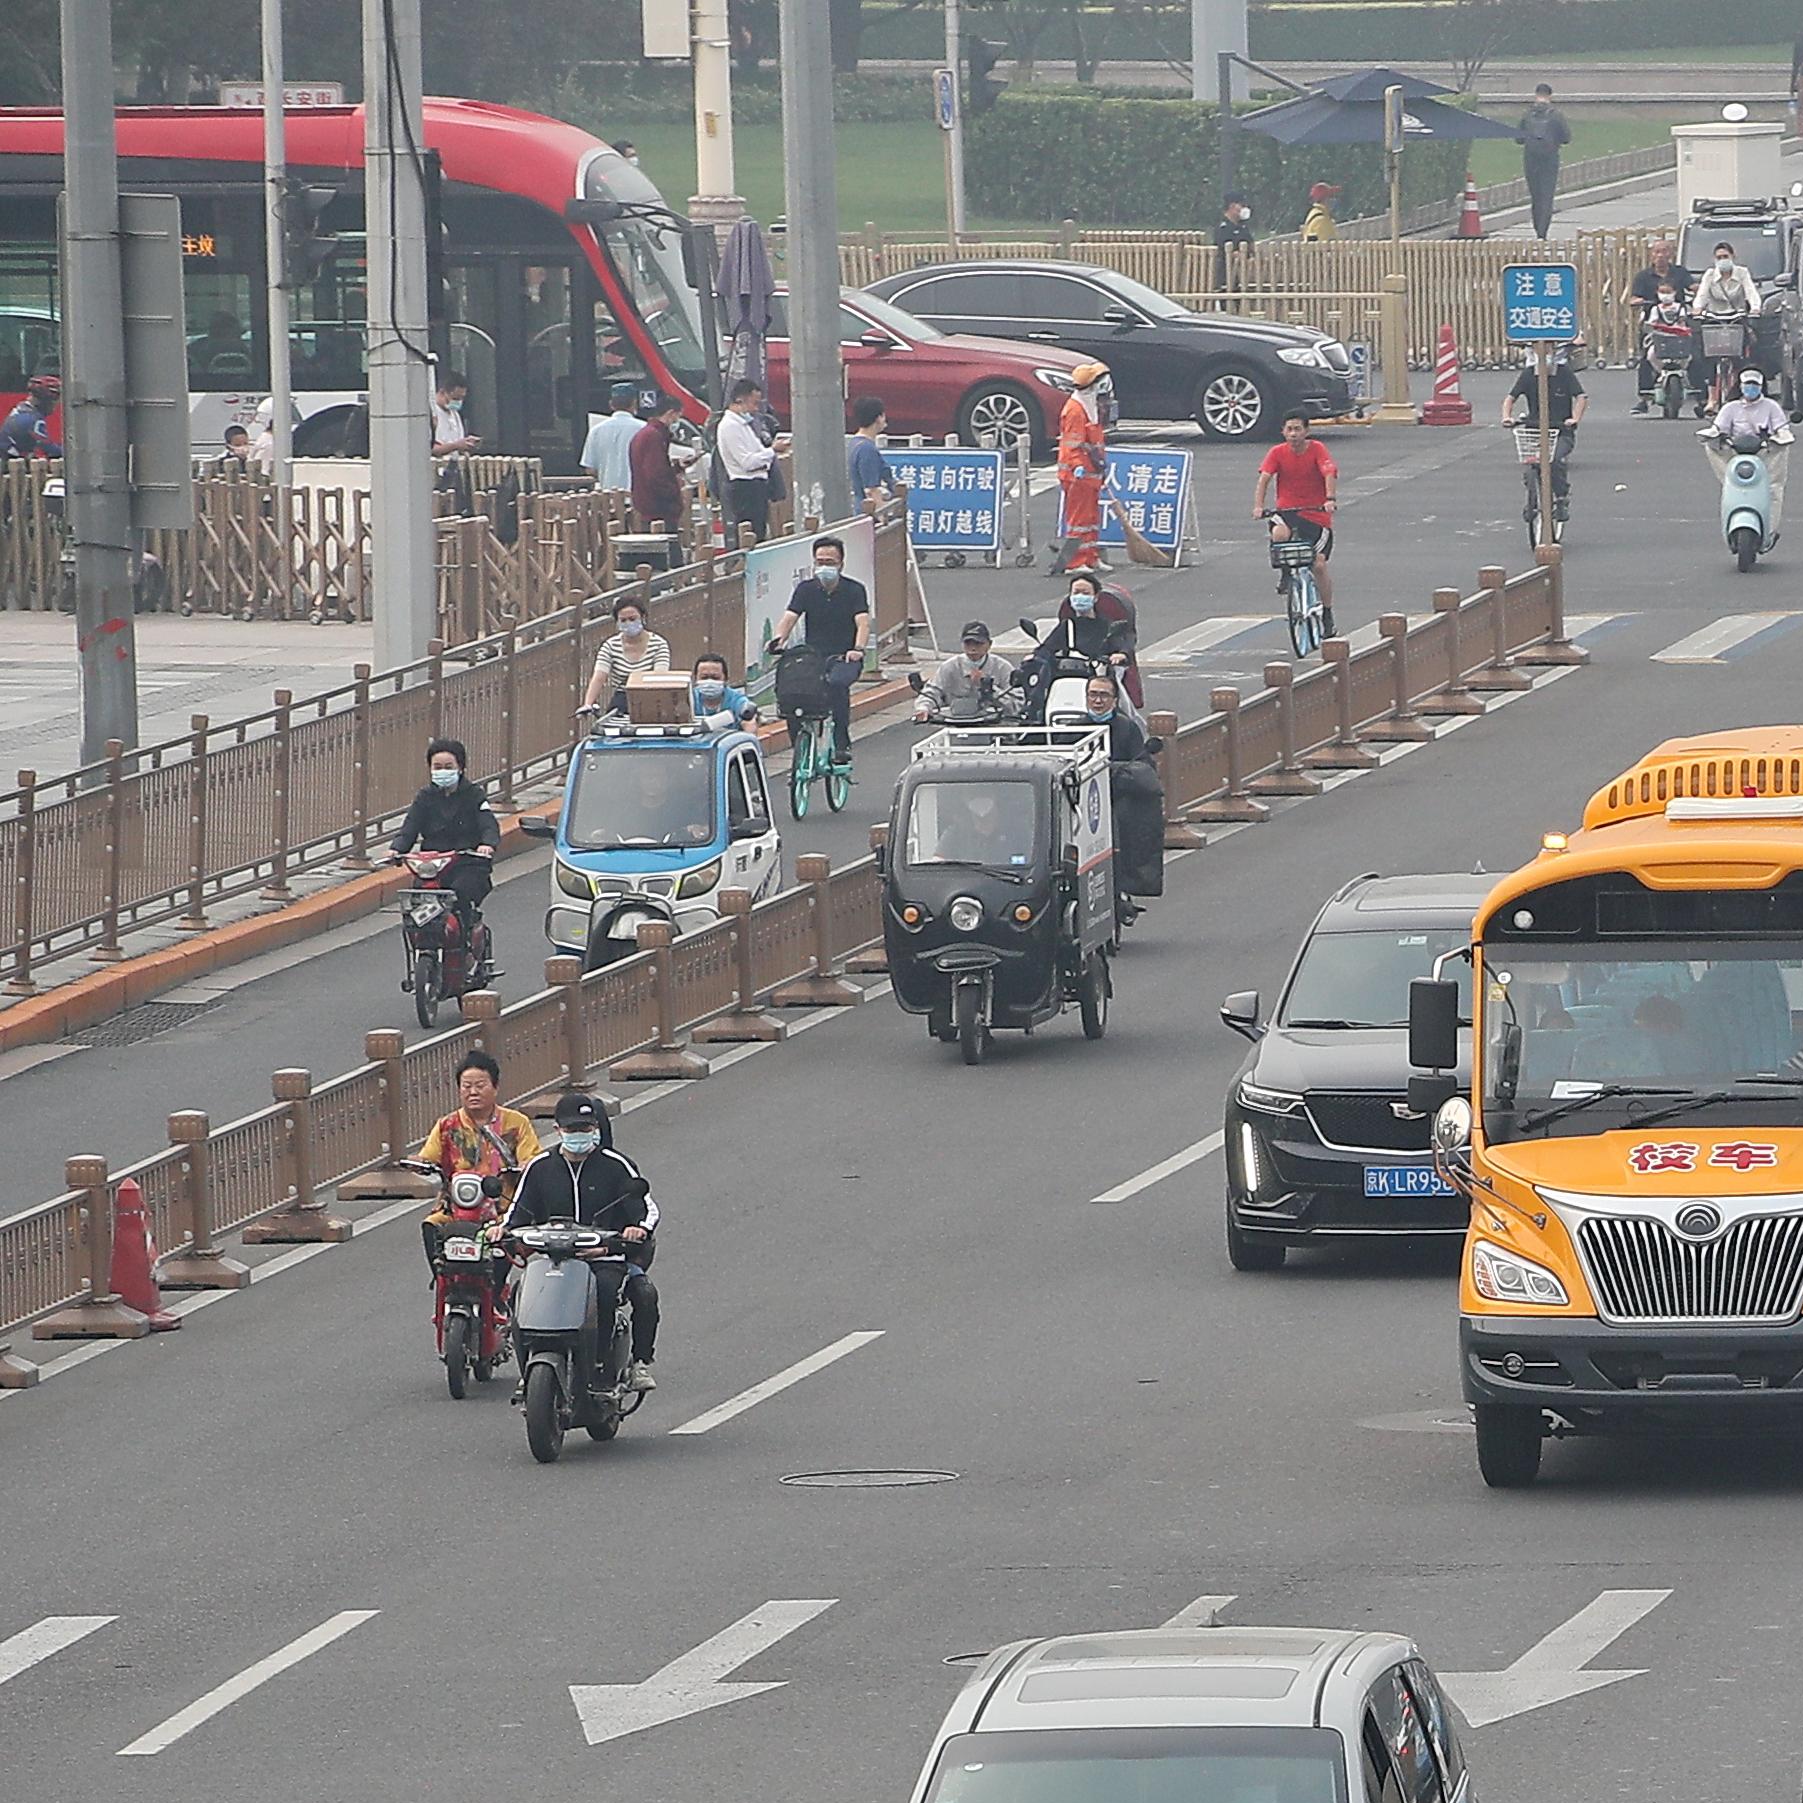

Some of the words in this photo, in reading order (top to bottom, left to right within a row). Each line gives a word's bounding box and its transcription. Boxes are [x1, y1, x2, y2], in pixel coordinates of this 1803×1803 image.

[1515, 272, 1563, 297] 注意
[1509, 306, 1573, 329] 交通安全
[1629, 1141, 1777, 1173] 校车
